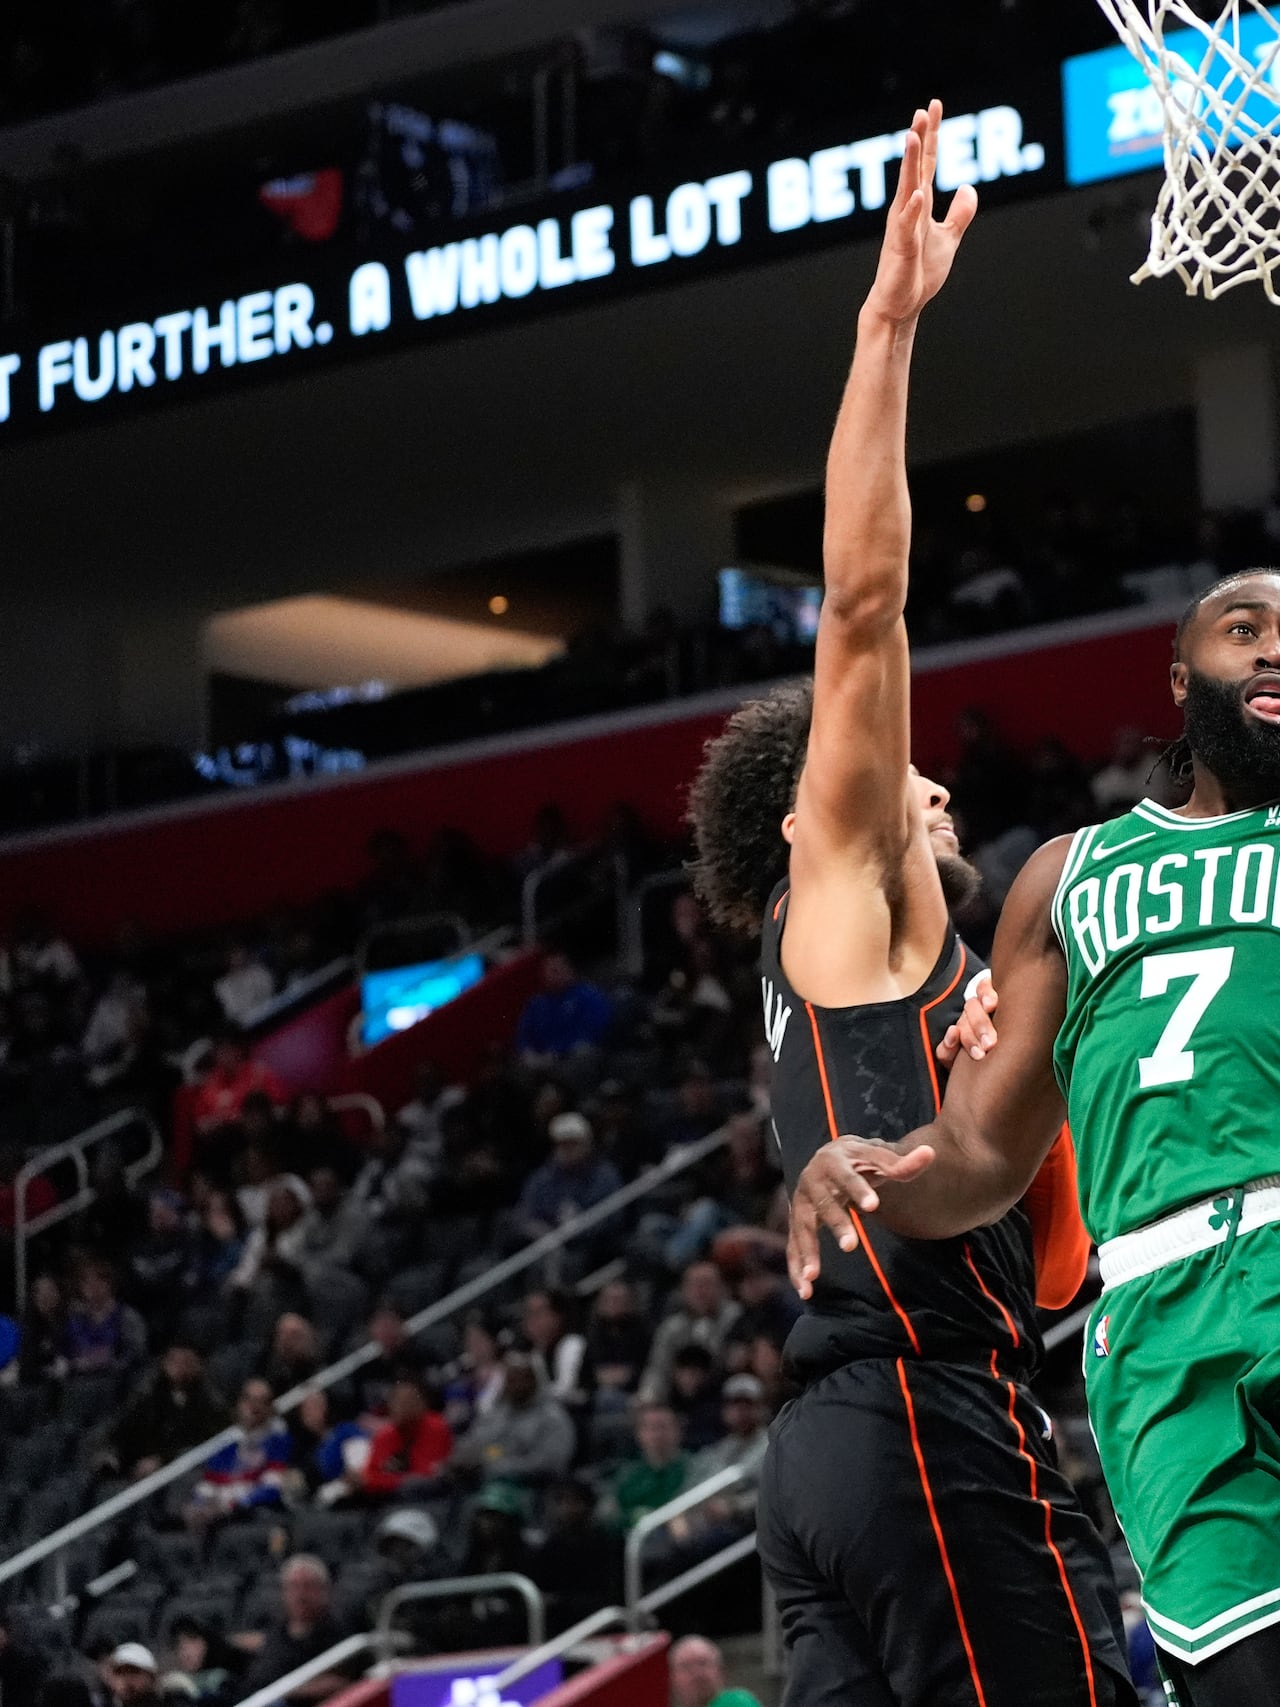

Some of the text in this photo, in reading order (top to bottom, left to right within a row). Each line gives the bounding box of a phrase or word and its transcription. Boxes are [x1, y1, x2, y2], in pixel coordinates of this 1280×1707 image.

[38, 283, 334, 412] FURTHER.
[349, 262, 391, 336] A
[405, 205, 615, 320] WHOLE
[630, 170, 752, 267] LOT
[767, 105, 1045, 233] BETER.
[1138, 946, 1235, 1089] 7
